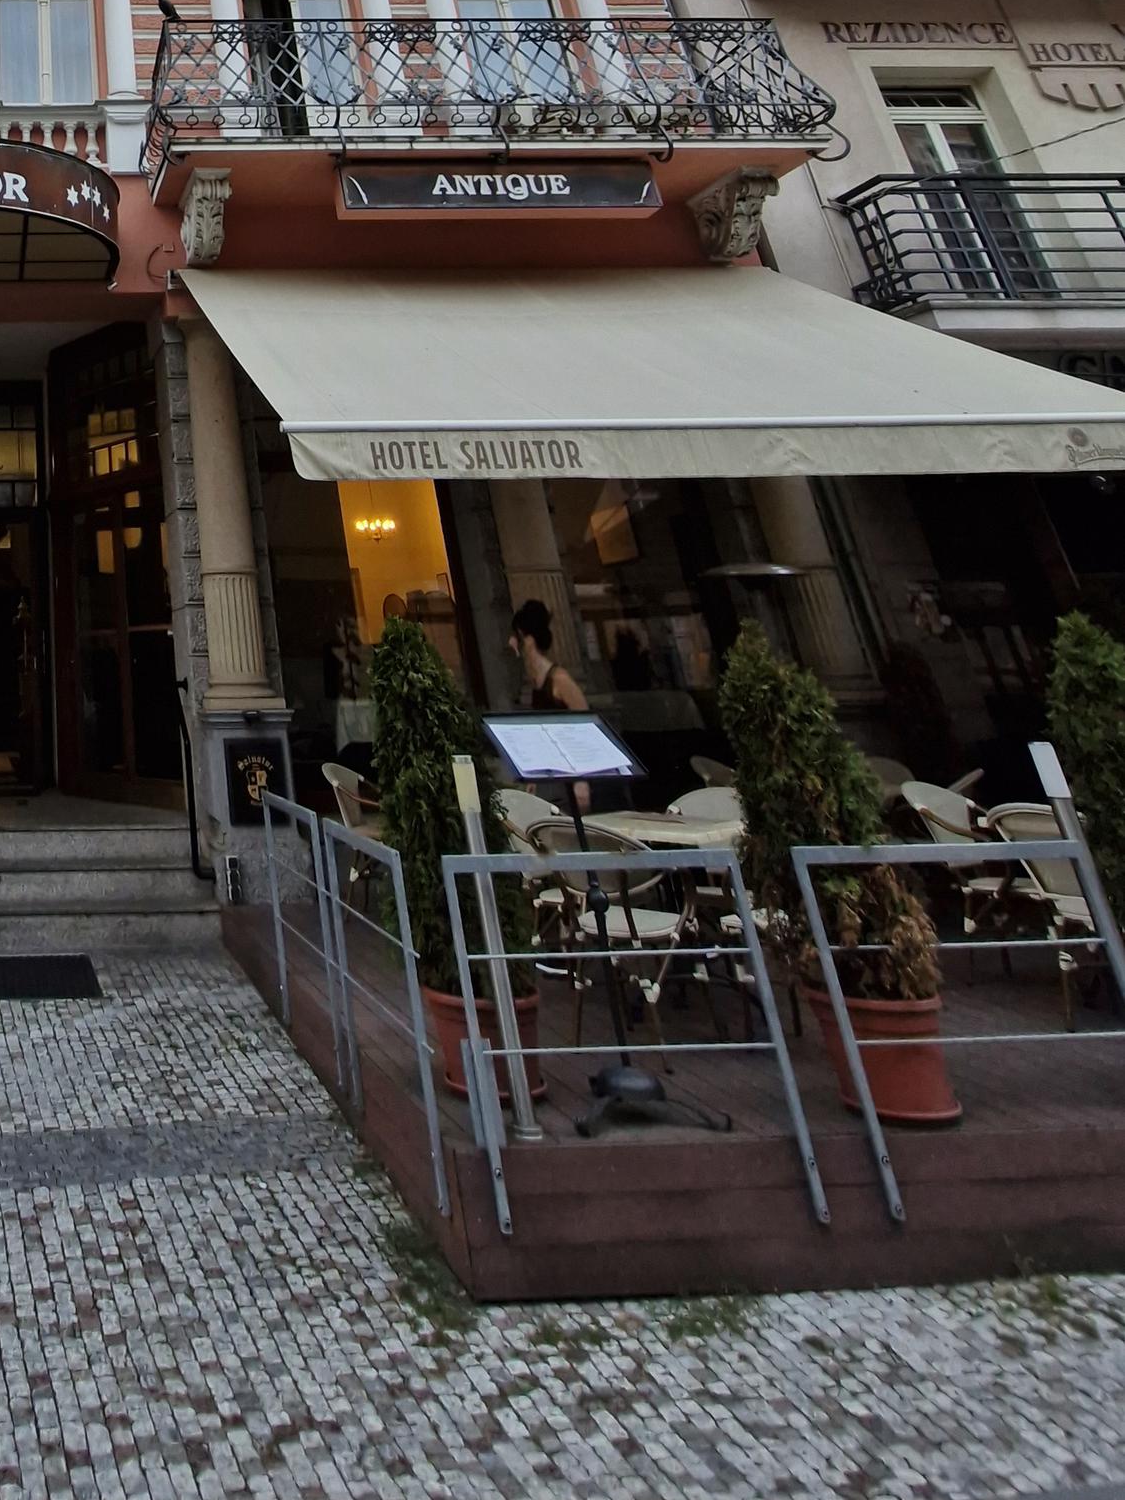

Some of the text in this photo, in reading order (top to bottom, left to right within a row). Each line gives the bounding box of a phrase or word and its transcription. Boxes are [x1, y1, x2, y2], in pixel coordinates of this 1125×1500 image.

[819, 21, 1015, 45] REZIDENCE
[1029, 42, 1125, 63] HOTEL
[431, 173, 571, 201] ANTIQUE
[369, 439, 584, 470] HOTEL SALVATOR
